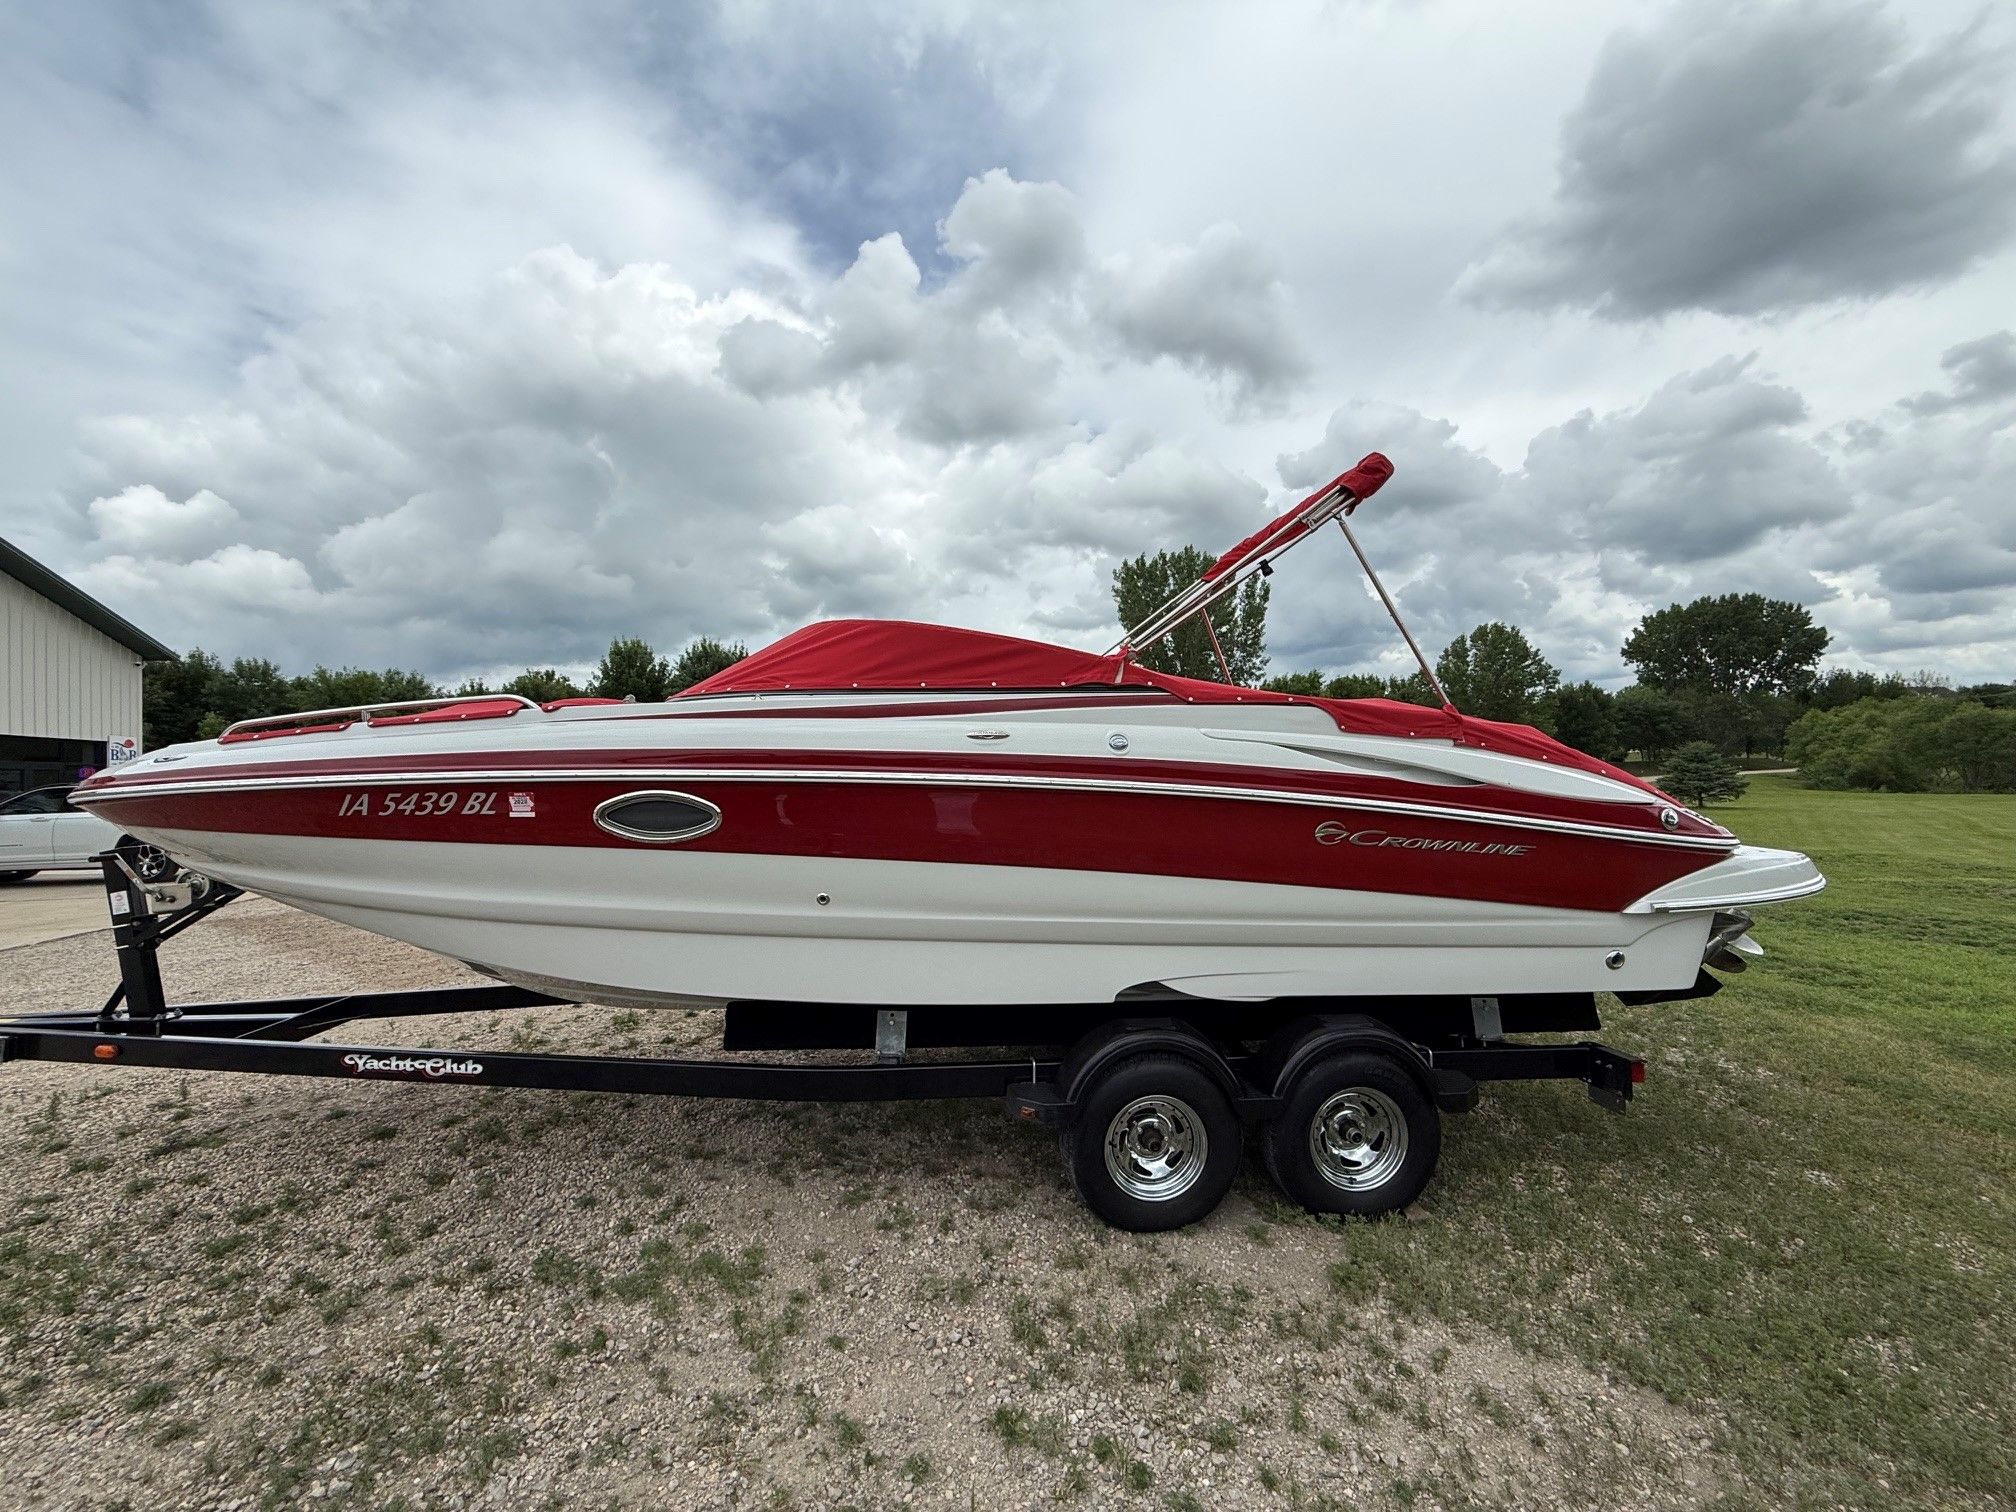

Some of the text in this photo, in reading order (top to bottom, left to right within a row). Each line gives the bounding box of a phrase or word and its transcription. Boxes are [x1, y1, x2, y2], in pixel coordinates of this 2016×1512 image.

[338, 791, 498, 817] IA 5439 BL
[1349, 829, 1537, 856] CROWNLINE
